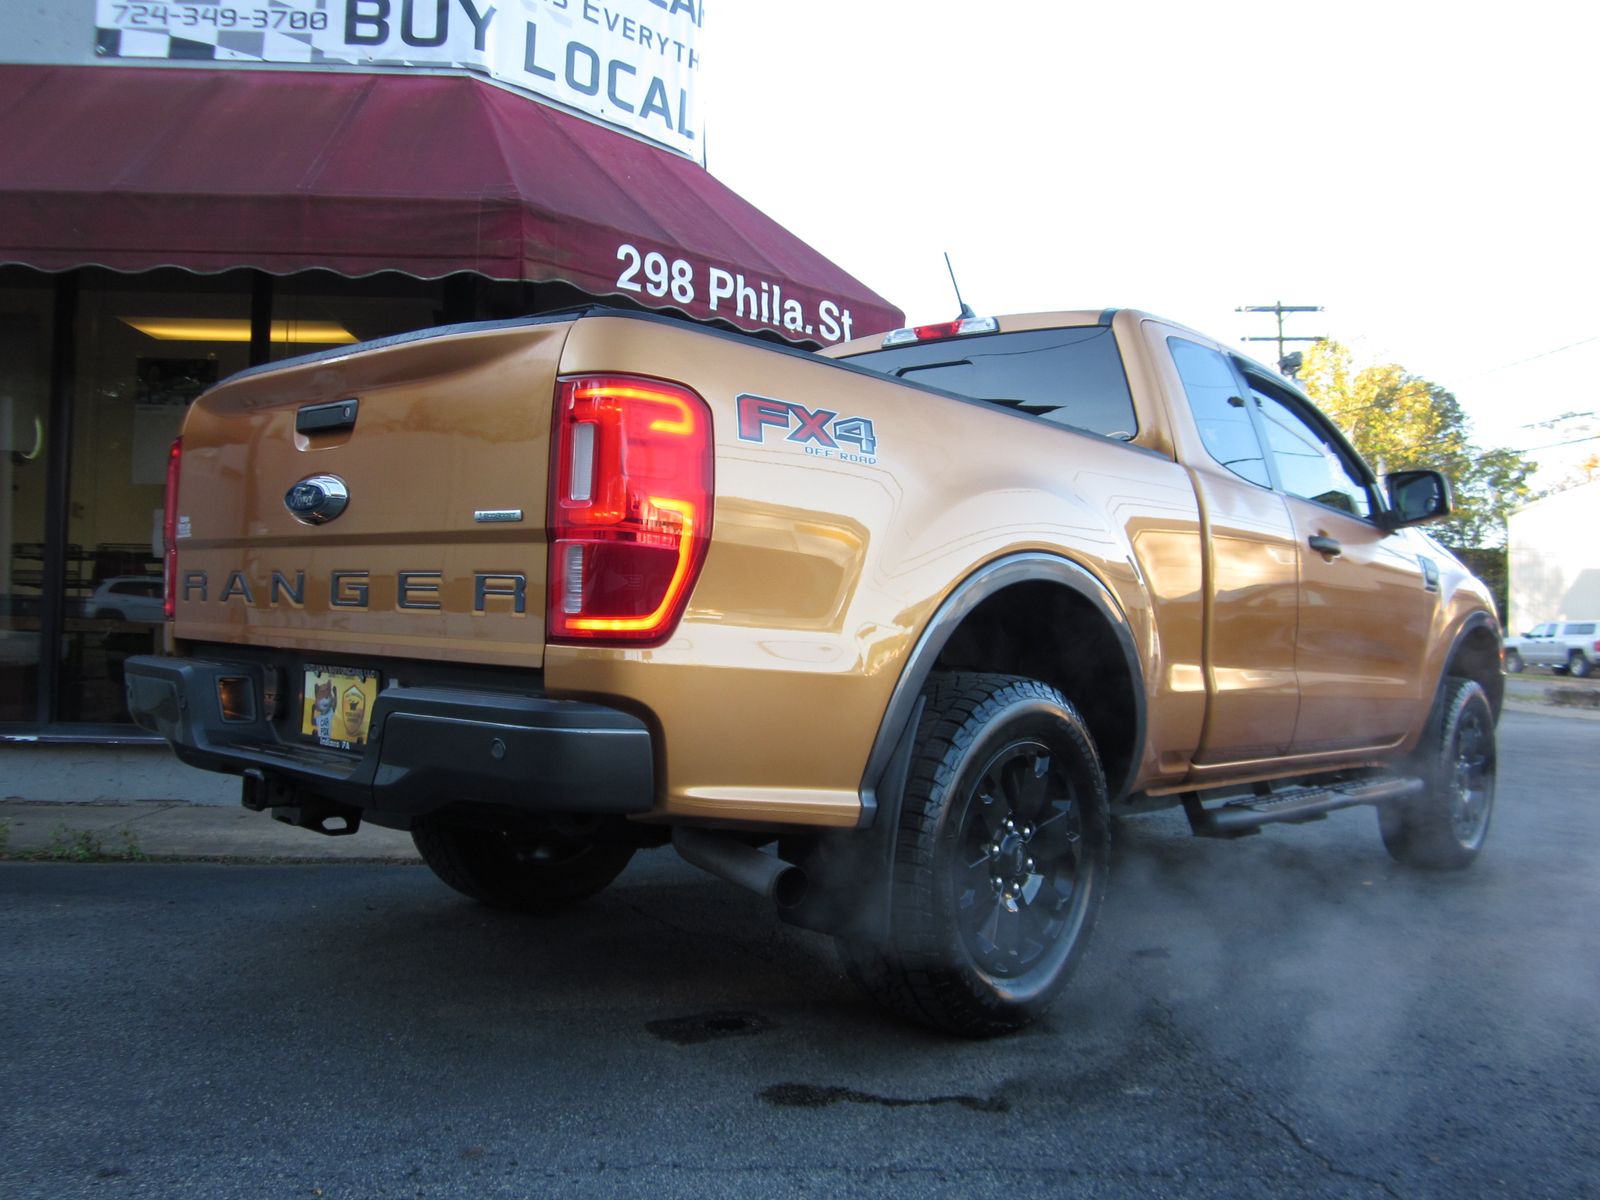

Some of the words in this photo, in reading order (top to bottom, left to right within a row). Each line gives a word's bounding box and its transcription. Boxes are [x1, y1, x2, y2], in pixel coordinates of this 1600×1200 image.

[111, 4, 328, 30] 724-349-3700
[344, 0, 498, 51] BUY
[523, 20, 696, 141] LOCAL
[616, 243, 695, 304] 298
[709, 266, 813, 336] Phila.
[818, 299, 853, 343] St
[735, 392, 877, 456] FX4
[804, 446, 834, 457] OFF
[839, 453, 877, 465] ROAD
[182, 569, 527, 614] RANGER
